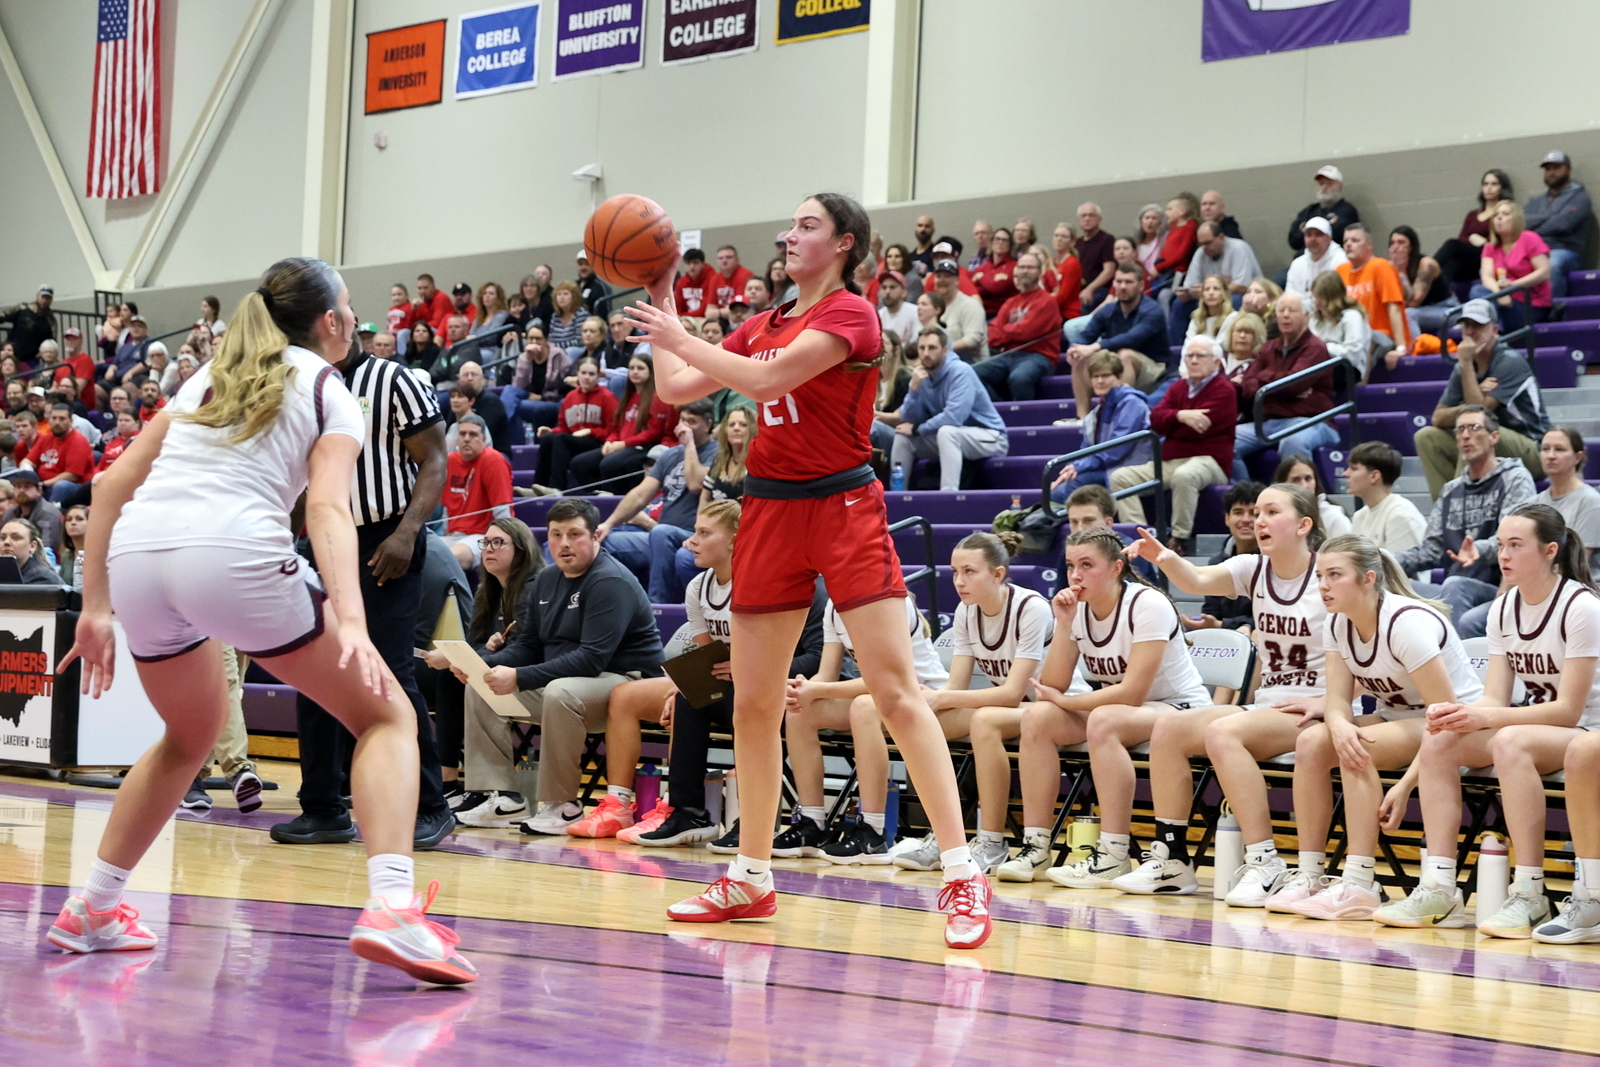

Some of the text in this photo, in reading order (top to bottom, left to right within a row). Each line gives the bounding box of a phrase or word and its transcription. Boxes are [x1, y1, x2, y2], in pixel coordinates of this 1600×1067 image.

[568, 3, 632, 32] BLUFFTON
[475, 26, 521, 50] BEREA
[558, 26, 640, 57] UNIVERSITY
[669, 13, 747, 48] COLLEGE
[383, 42, 426, 63] ANDERSON
[466, 47, 527, 74] COLLEGE
[378, 71, 428, 92] UNIVERSITY
[705, 618, 730, 637] ENO
[1258, 612, 1312, 637] GENOA
[0, 650, 47, 674] RMERS
[1264, 640, 1308, 672] 24
[1506, 651, 1560, 675] GENOA
[1352, 674, 1404, 693] ENOA
[3, 734, 30, 747] LAKEVIEW
